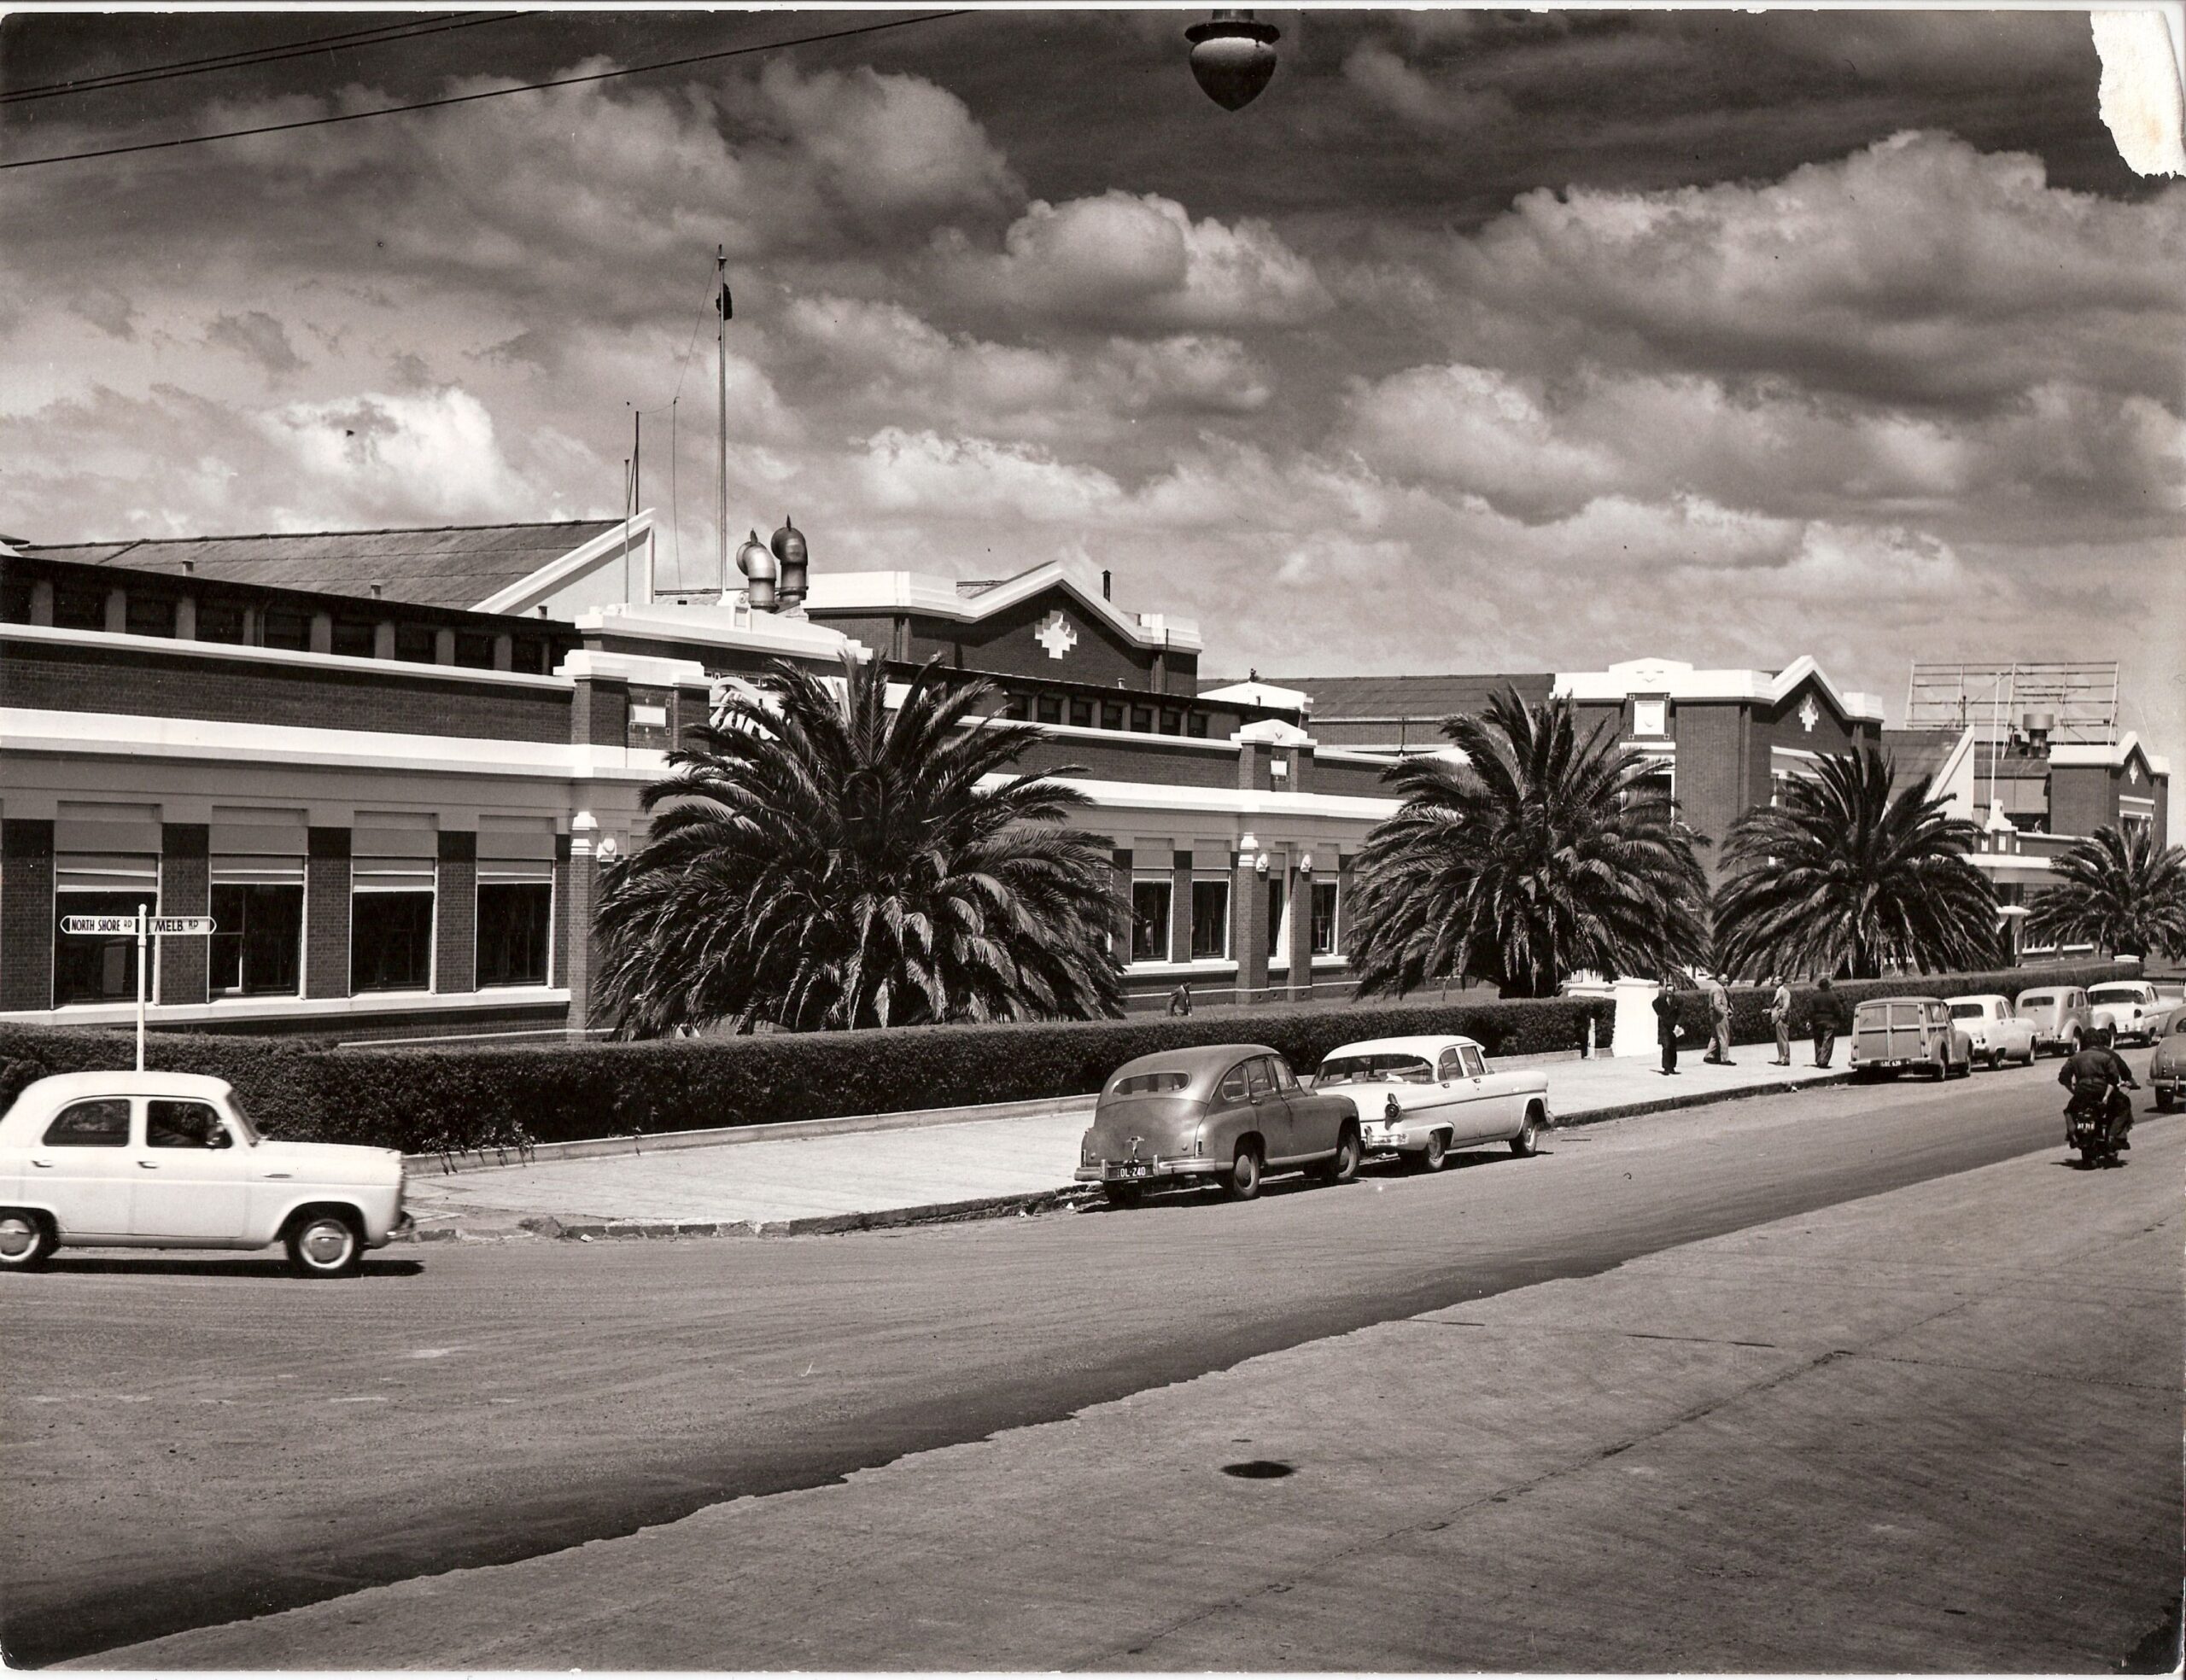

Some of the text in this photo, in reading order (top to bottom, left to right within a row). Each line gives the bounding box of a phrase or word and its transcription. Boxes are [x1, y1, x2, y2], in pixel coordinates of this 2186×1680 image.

[72, 919, 132, 931] NORTH SHORE RD
[189, 919, 198, 928] RD
